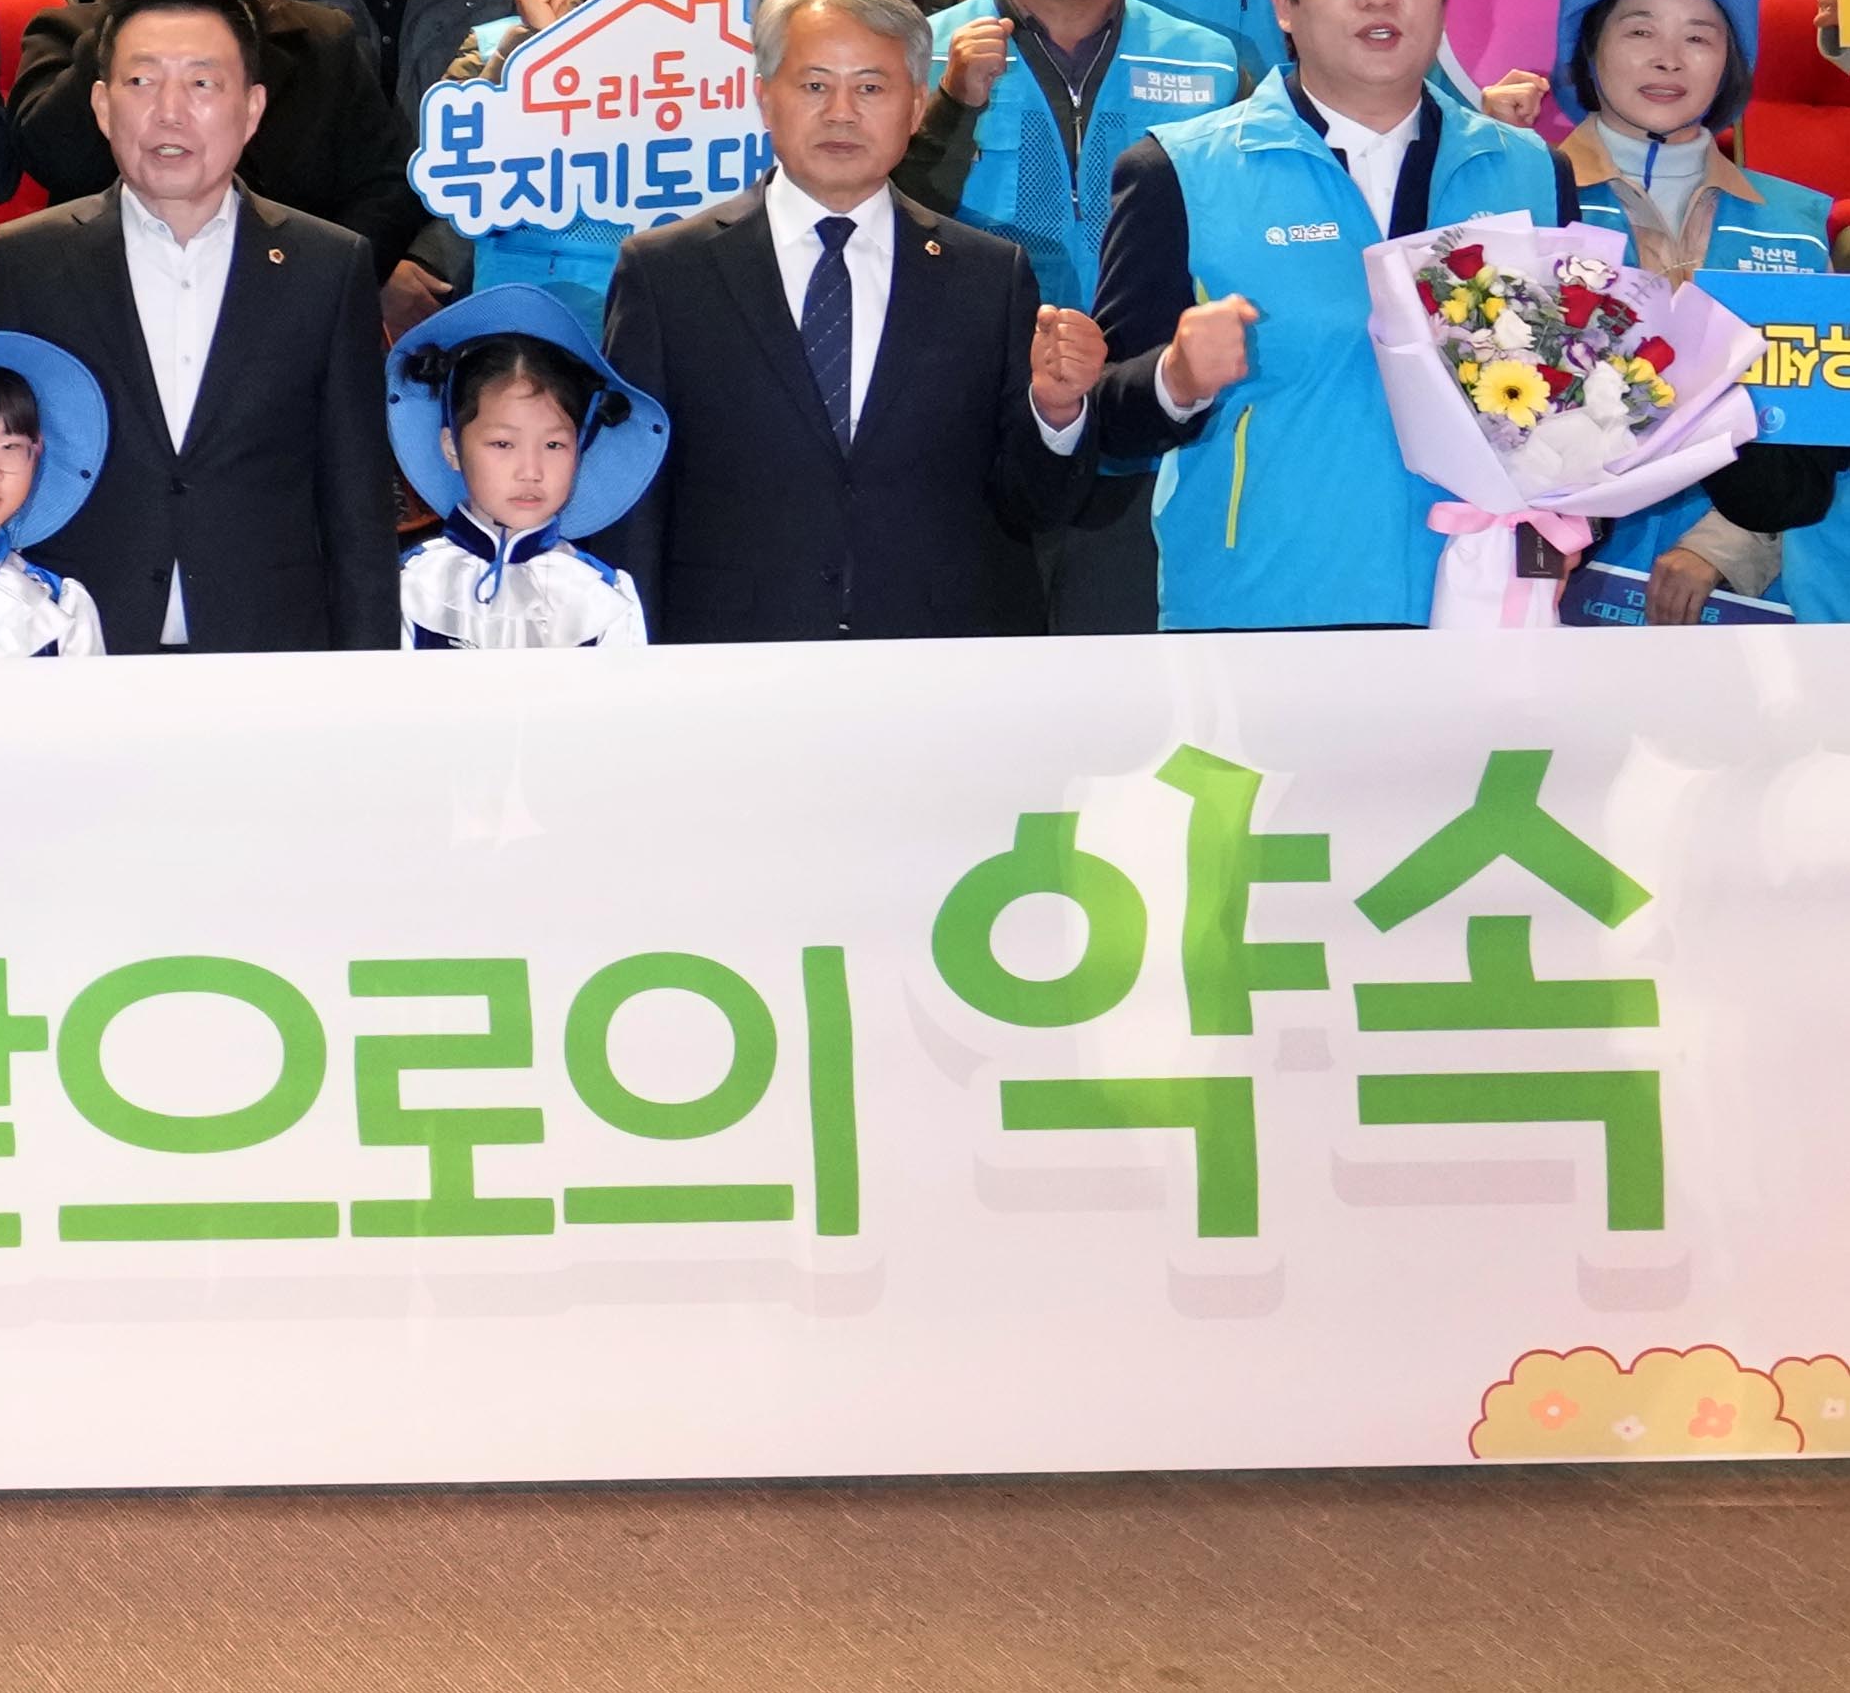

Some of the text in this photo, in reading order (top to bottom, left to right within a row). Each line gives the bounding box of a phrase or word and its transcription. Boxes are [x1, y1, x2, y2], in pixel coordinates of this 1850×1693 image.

[1147, 72, 1192, 87] 화산면
[540, 50, 746, 136] 우리동네
[1133, 86, 1211, 104] 복지기동대
[1289, 222, 1341, 241] 화순군
[1750, 246, 1797, 263] 화산면
[931, 741, 1668, 1238] 약속
